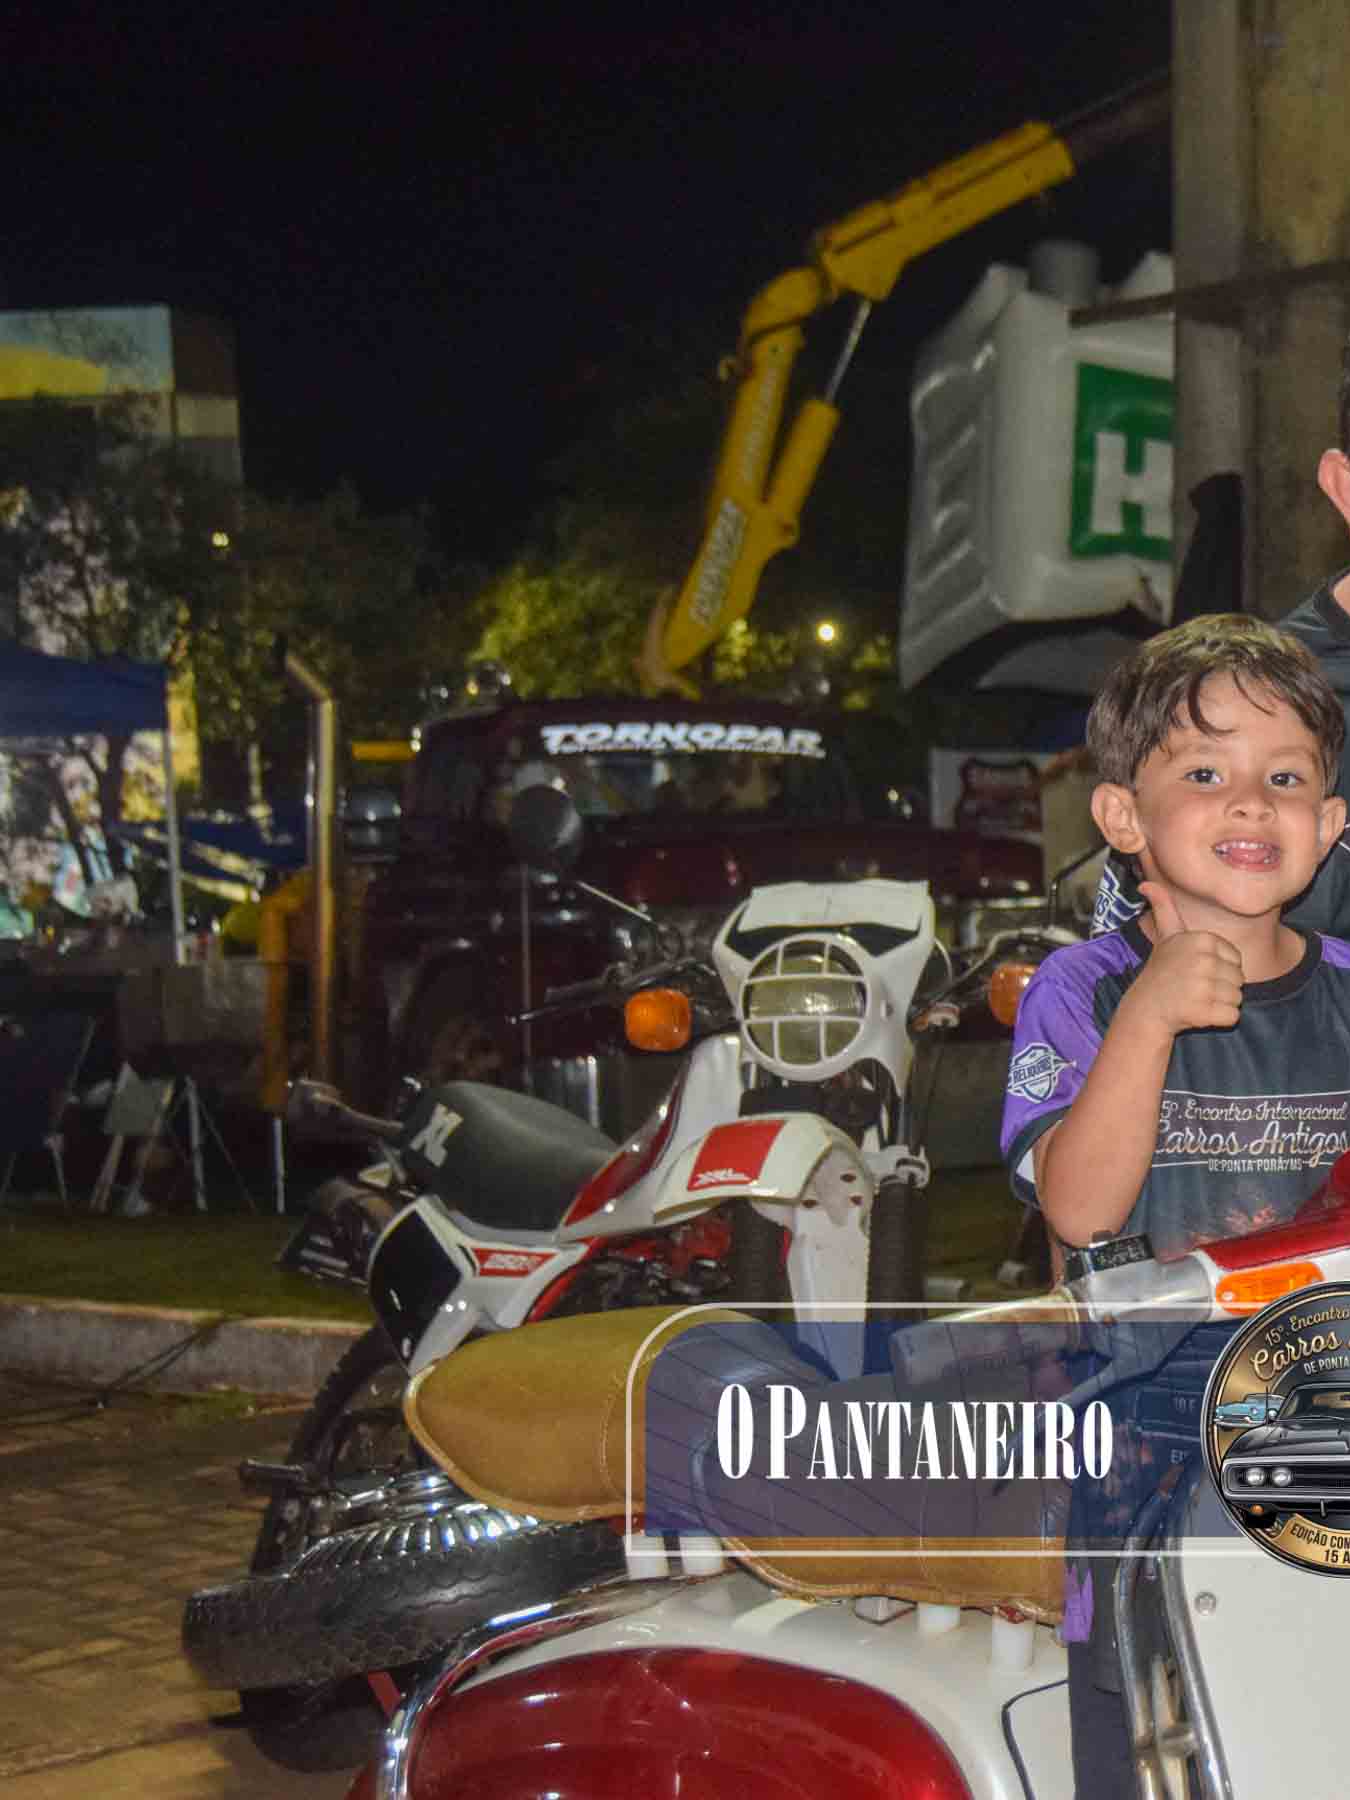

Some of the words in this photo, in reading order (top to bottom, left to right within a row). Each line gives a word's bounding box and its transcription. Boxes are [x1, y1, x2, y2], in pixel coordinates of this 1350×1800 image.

[541, 722, 826, 758] TORNOPAR
[1160, 1101, 1182, 1119] 5º.
[1185, 1098, 1252, 1121] Encontro
[1257, 1100, 1348, 1121] Internacional
